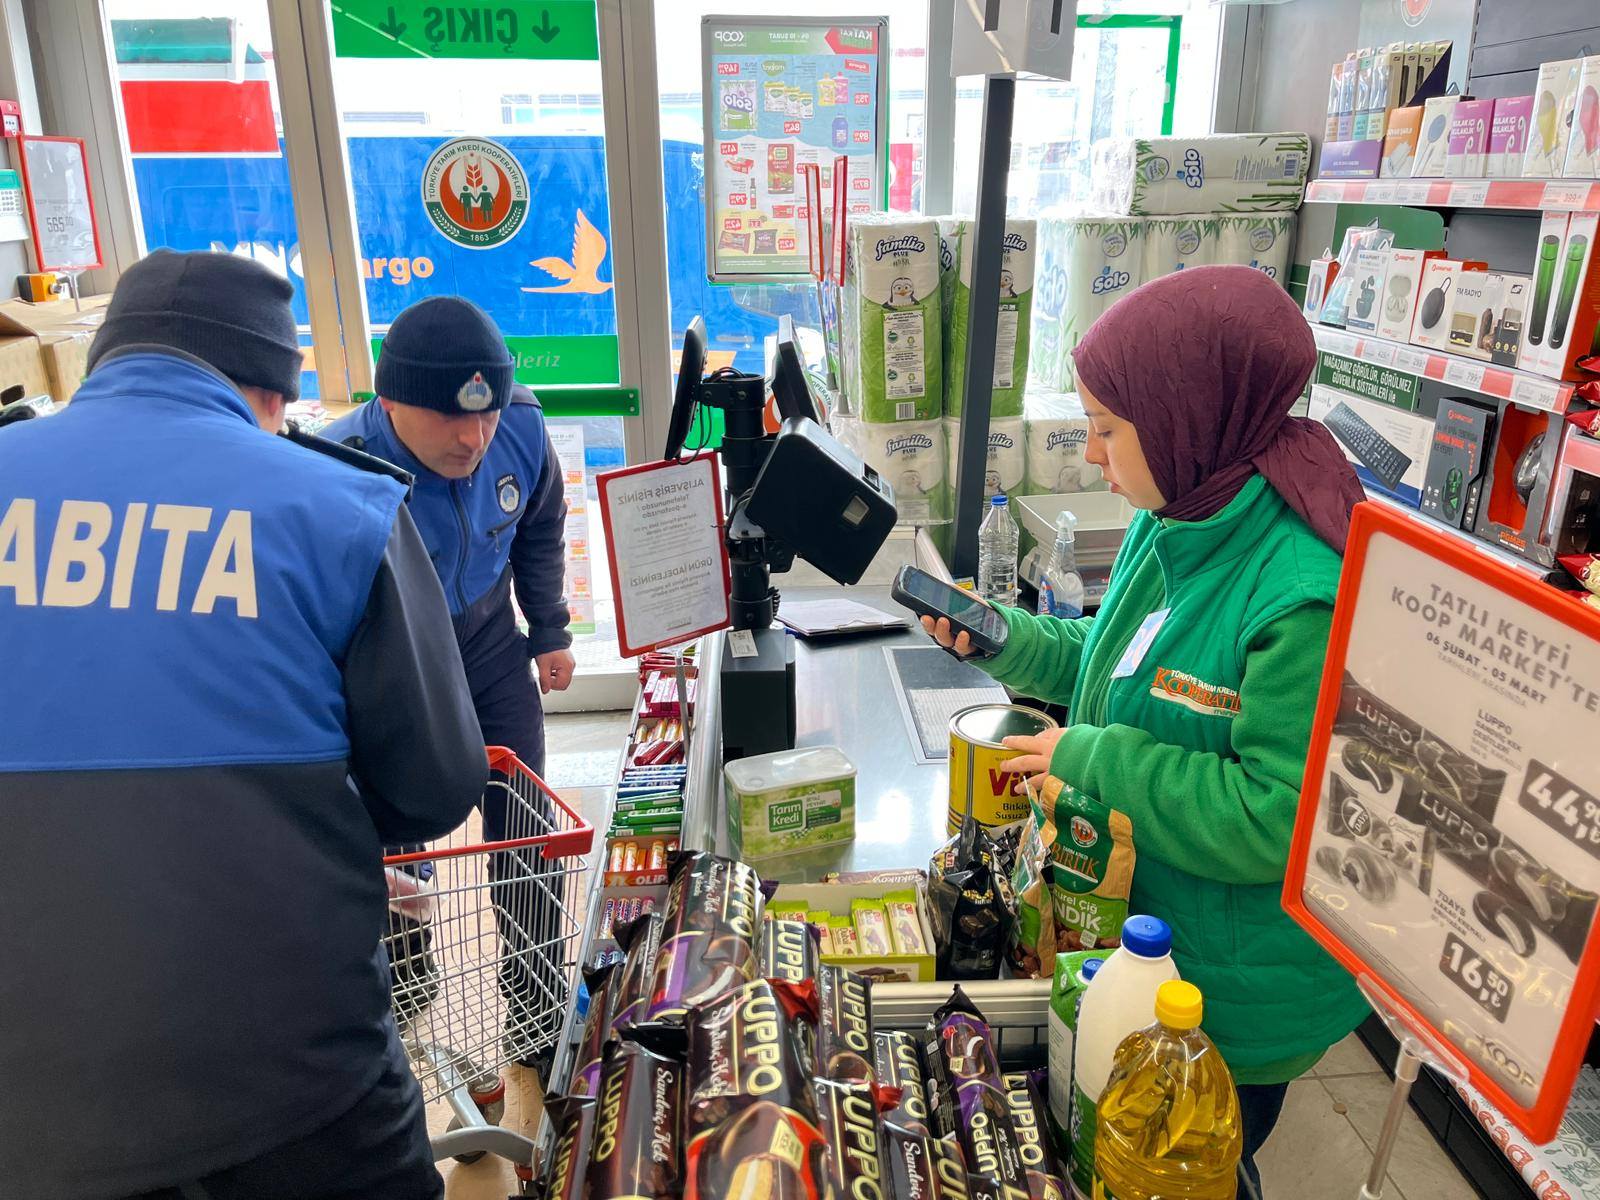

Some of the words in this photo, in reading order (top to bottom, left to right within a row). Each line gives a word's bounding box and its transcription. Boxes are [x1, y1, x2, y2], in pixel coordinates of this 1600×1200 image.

[429, 165, 440, 198] TÜRKİYE
[438, 149, 456, 167] TARIM
[457, 144, 481, 153] KREDİ
[481, 144, 523, 198] KOOPERATİFLERİ
[1184, 148, 1203, 188] Solo
[470, 233, 490, 242] 1863
[876, 235, 925, 261] familia
[1092, 270, 1130, 294] Solo
[886, 433, 933, 456] familia
[0, 498, 258, 618] ABITA
[1391, 586, 1451, 628] KOOP
[1430, 583, 1489, 628] TATLI
[1496, 617, 1572, 670] KEYFİ
[1171, 669, 1198, 685] TÜRKİYE
[1426, 632, 1441, 645] 06
[1442, 640, 1480, 667] ŞUBAT
[1491, 668, 1507, 682] 05
[1509, 677, 1547, 704] MART
[1355, 696, 1413, 746] LUPPO
[1478, 709, 1512, 735] LUPPO
[770, 803, 801, 815] Tarım
[773, 813, 800, 826] Kredi
[995, 811, 1022, 820] Susuz
[1003, 802, 1031, 811] Bitkis
[1419, 790, 1489, 850] LUPPO
[1079, 900, 1098, 915] Çiğ
[841, 967, 868, 1051] LUPPO
[743, 978, 782, 1096] LUPPO
[893, 1031, 927, 1119] LUPPO
[595, 1066, 627, 1163] LUPPO
[653, 1067, 673, 1127] Sandviç
[1000, 1074, 1043, 1166] LUPPO
[651, 1125, 672, 1163] Kek
[843, 1083, 883, 1200] LUPPO
